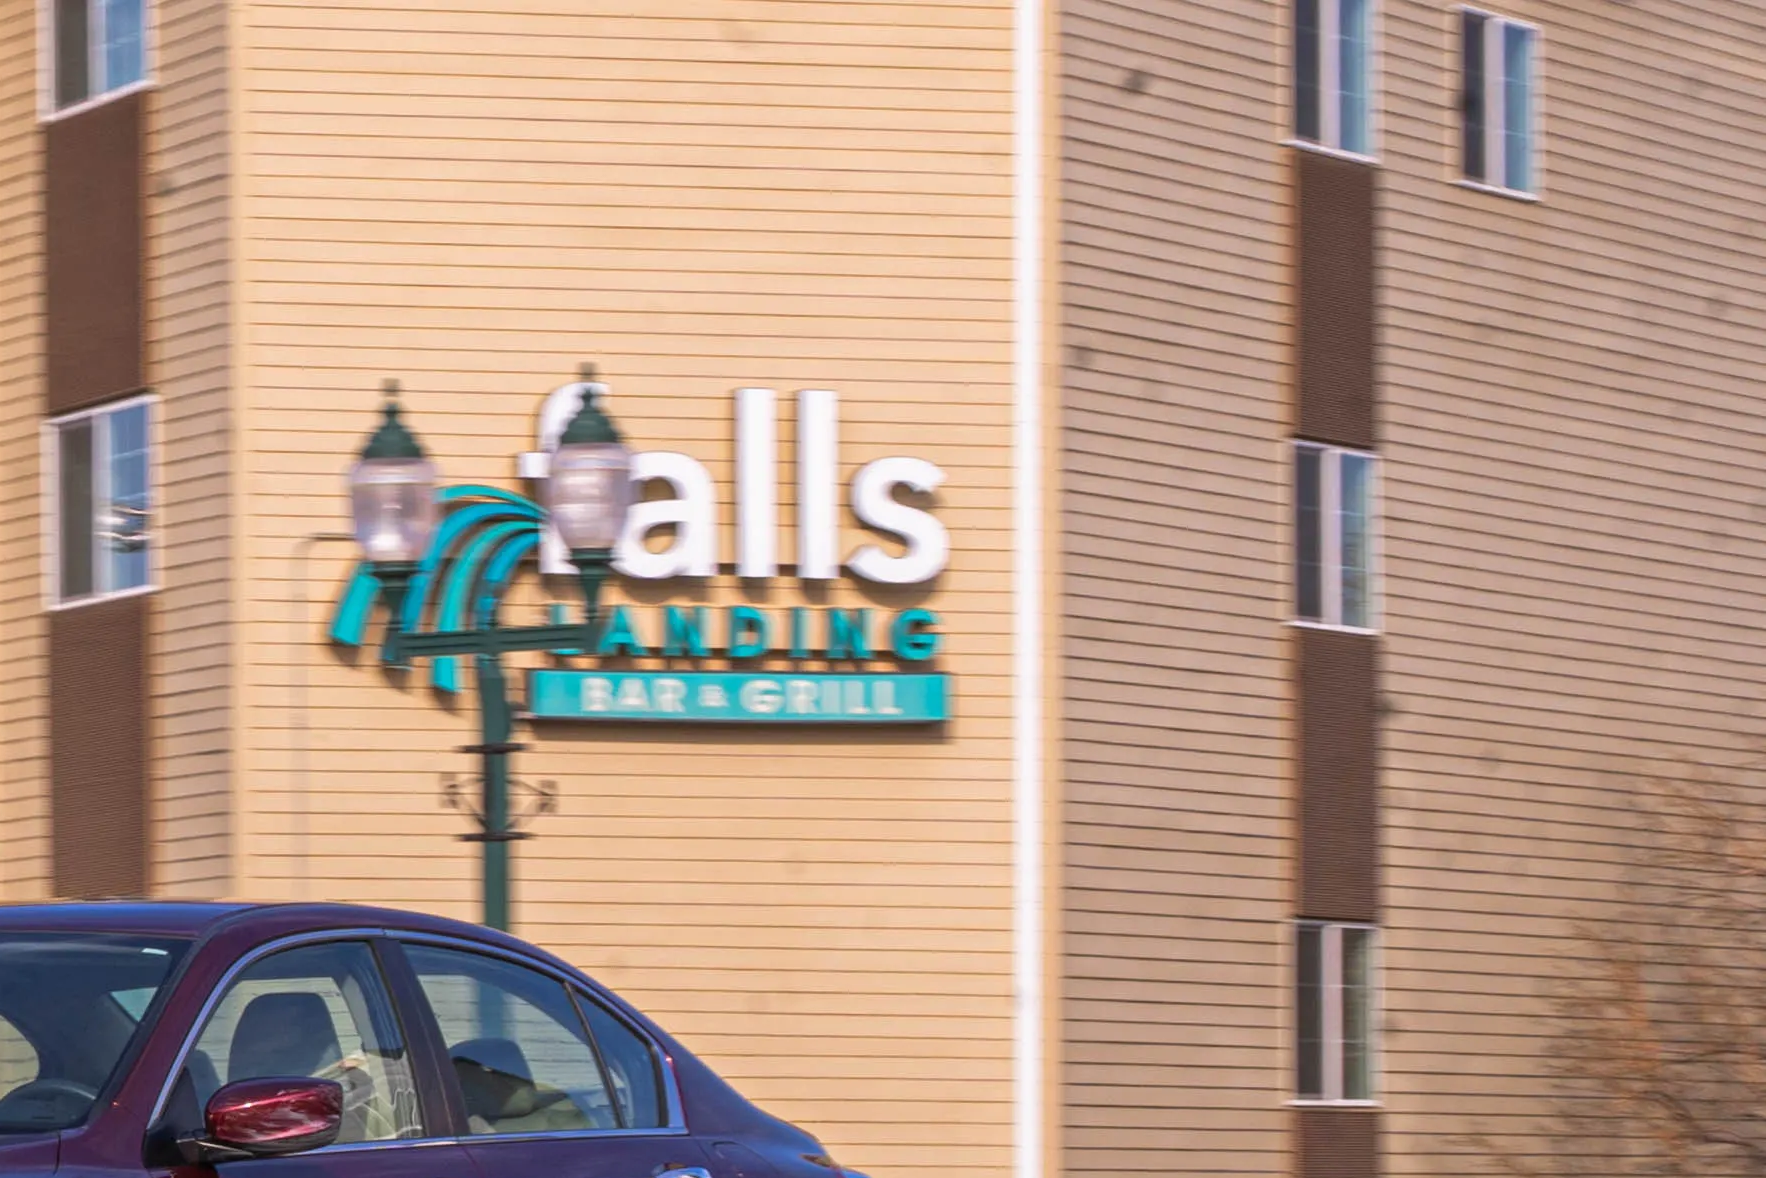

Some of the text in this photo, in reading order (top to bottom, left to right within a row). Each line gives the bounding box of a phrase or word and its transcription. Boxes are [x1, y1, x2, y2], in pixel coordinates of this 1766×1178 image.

[581, 677, 904, 715] BAR & GRILL
